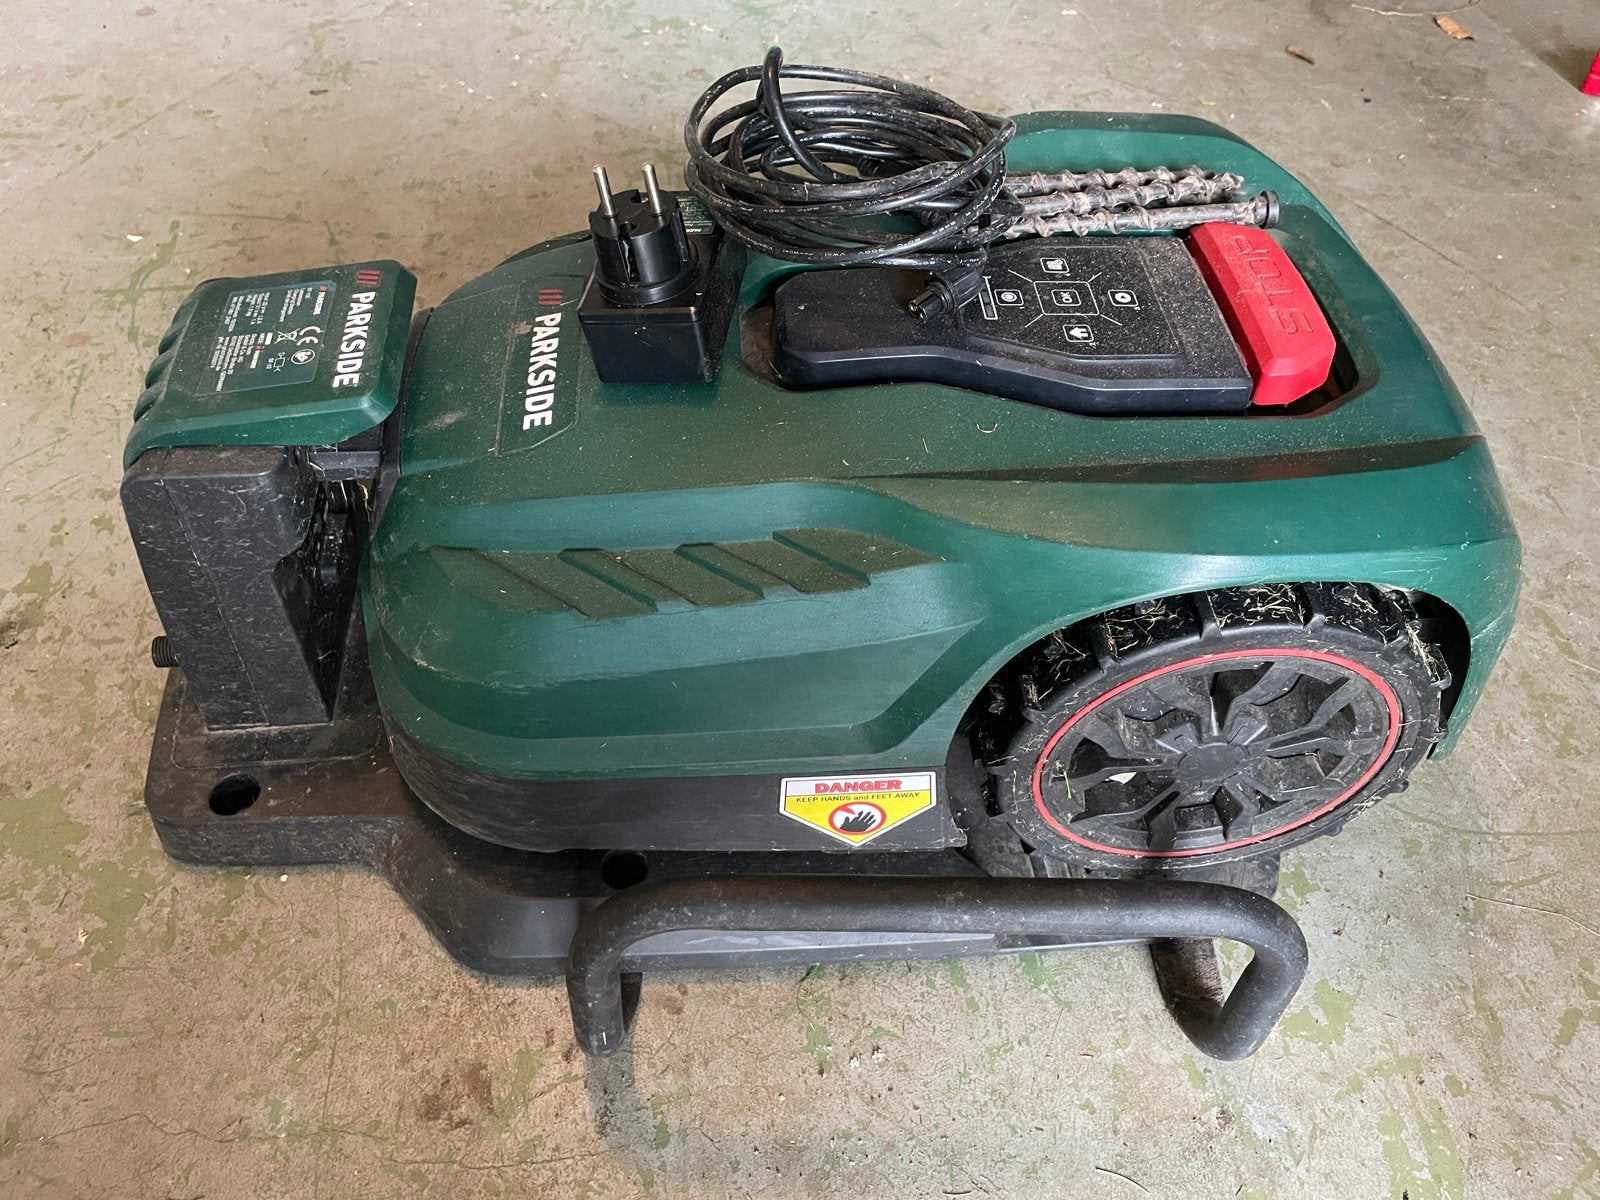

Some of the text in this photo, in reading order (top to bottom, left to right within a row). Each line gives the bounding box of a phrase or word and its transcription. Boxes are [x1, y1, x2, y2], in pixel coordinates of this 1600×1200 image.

[312, 291, 325, 315] PARKSIDE
[1060, 291, 1073, 304] OK
[1230, 235, 1314, 334] STOP
[333, 291, 376, 388] PARKSIDE
[513, 312, 562, 430] PARKSIDE
[815, 780, 902, 794] DANGER
